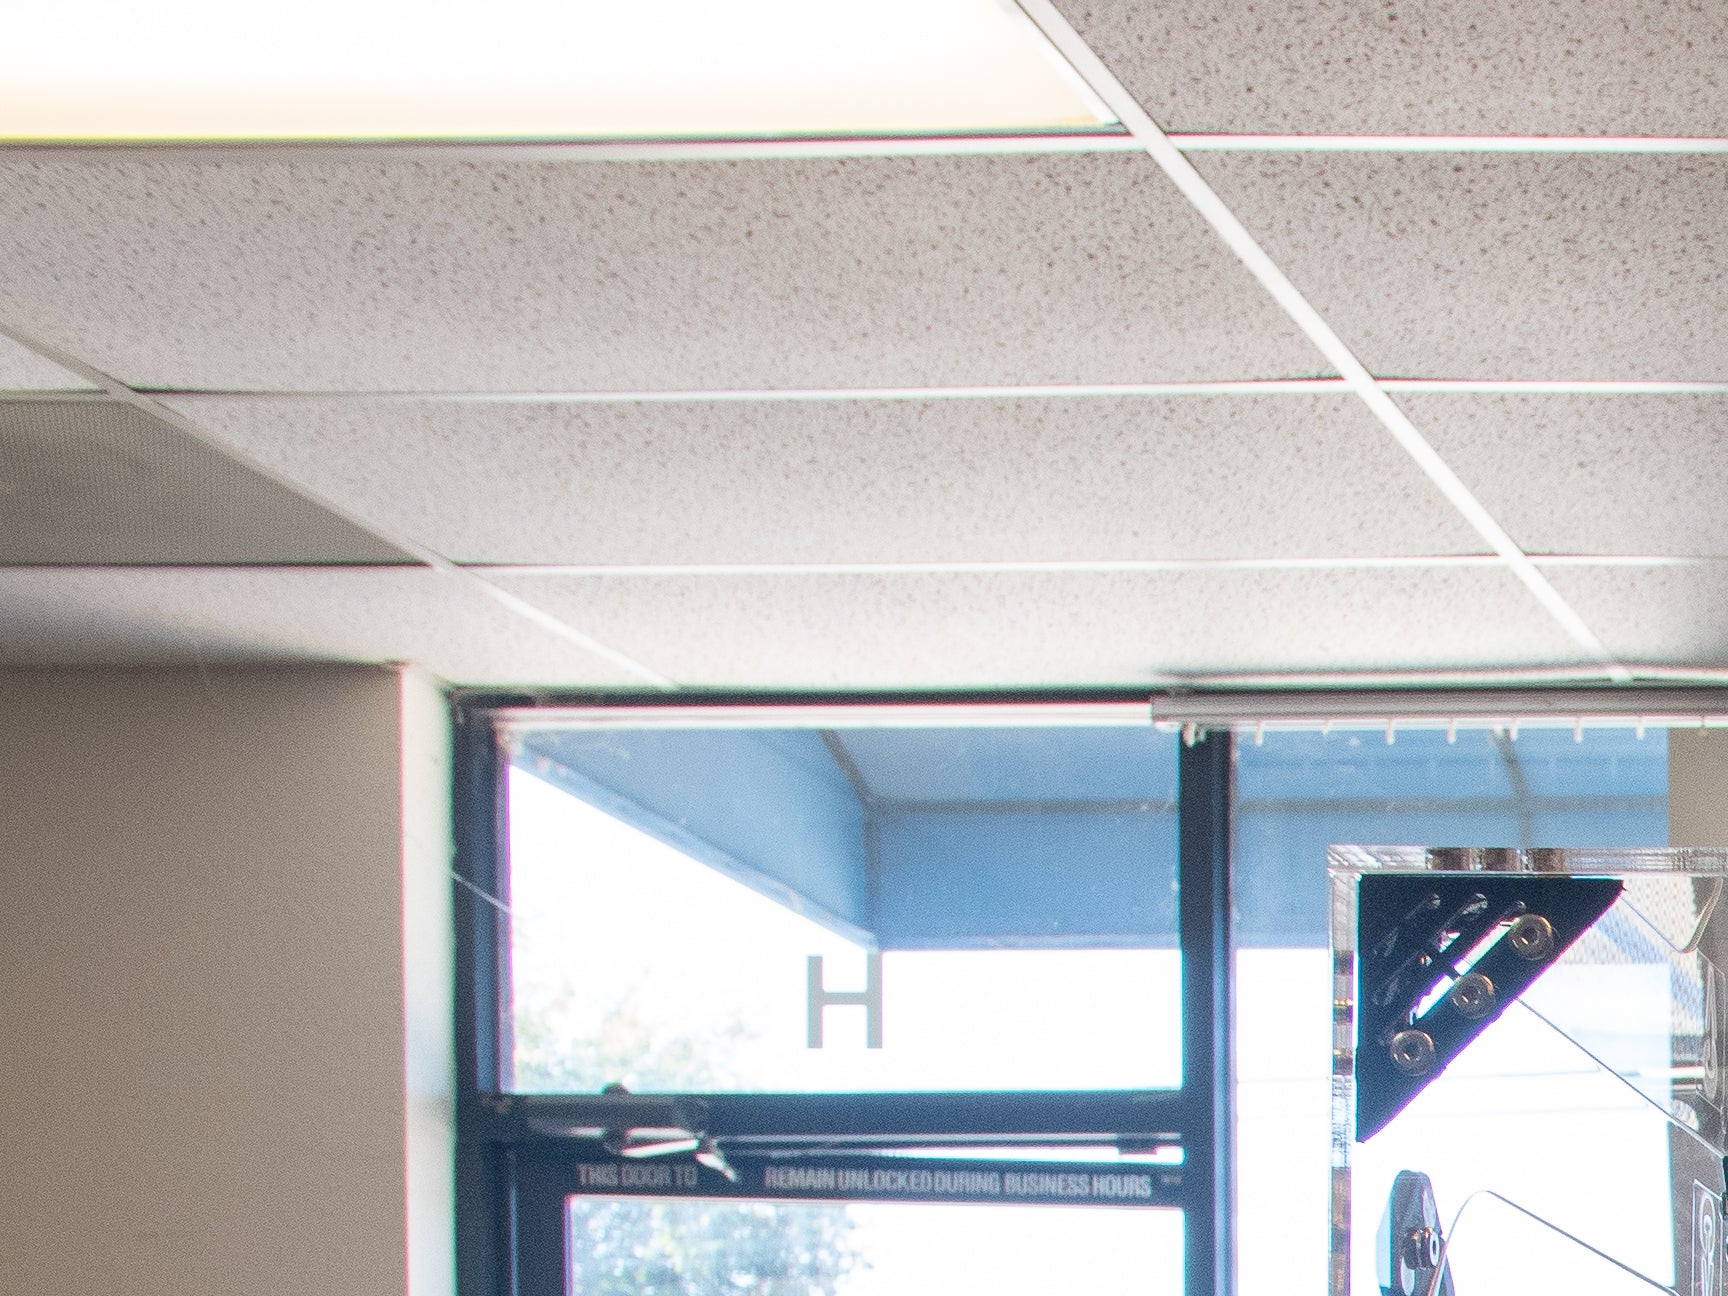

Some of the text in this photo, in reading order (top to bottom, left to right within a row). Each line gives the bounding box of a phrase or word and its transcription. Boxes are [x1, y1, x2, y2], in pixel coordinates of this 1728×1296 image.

[806, 954, 883, 1049] H
[576, 1164, 620, 1187] THIS
[622, 1165, 673, 1187] DOOR
[675, 1166, 698, 1188] TO
[764, 1166, 836, 1190] REMAIN
[838, 1169, 933, 1193] UNLOCKED
[934, 1171, 1001, 1195] DURING
[1004, 1173, 1091, 1196] BUSINESS
[1092, 1175, 1152, 1198] HOURS
